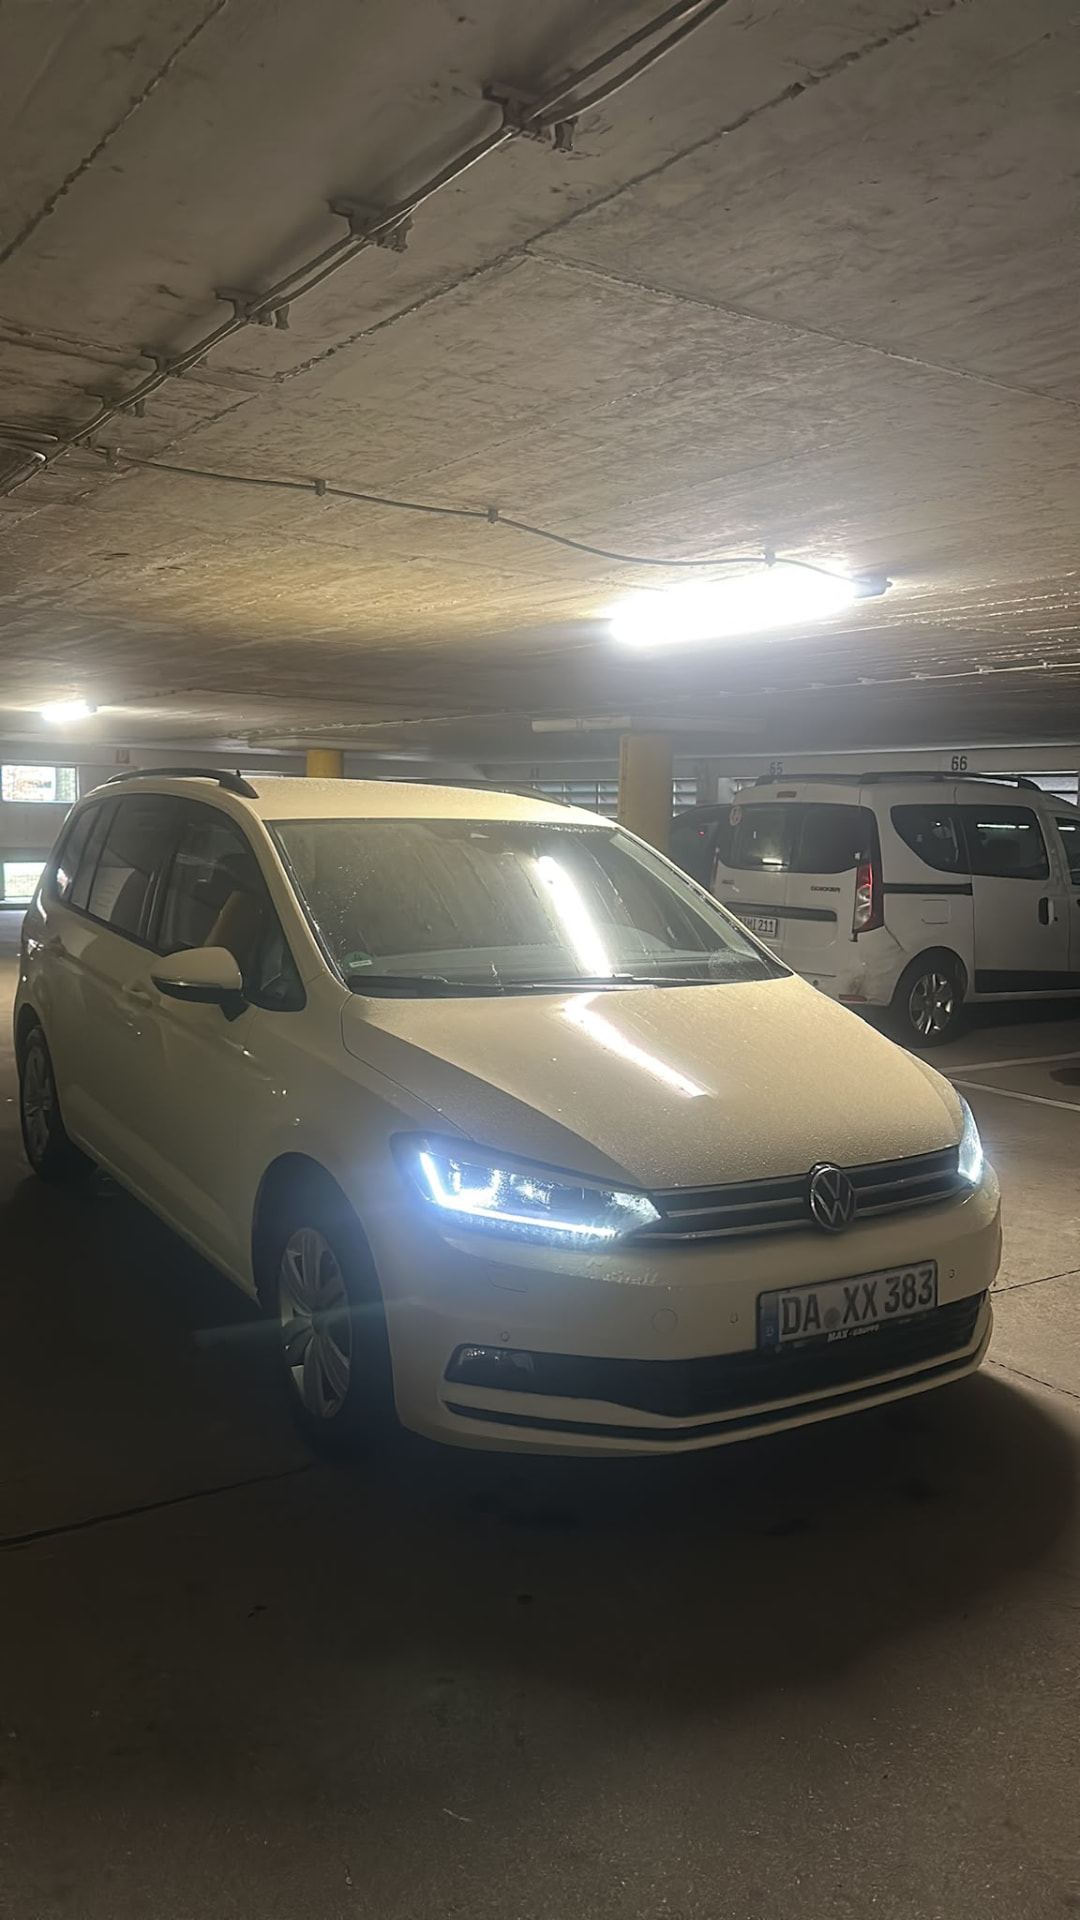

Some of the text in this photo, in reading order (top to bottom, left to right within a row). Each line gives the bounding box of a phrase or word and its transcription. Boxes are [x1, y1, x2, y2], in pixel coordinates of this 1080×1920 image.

[951, 755, 968, 771] 66
[757, 919, 774, 932] 211
[781, 1268, 934, 1336] DA XX 383
